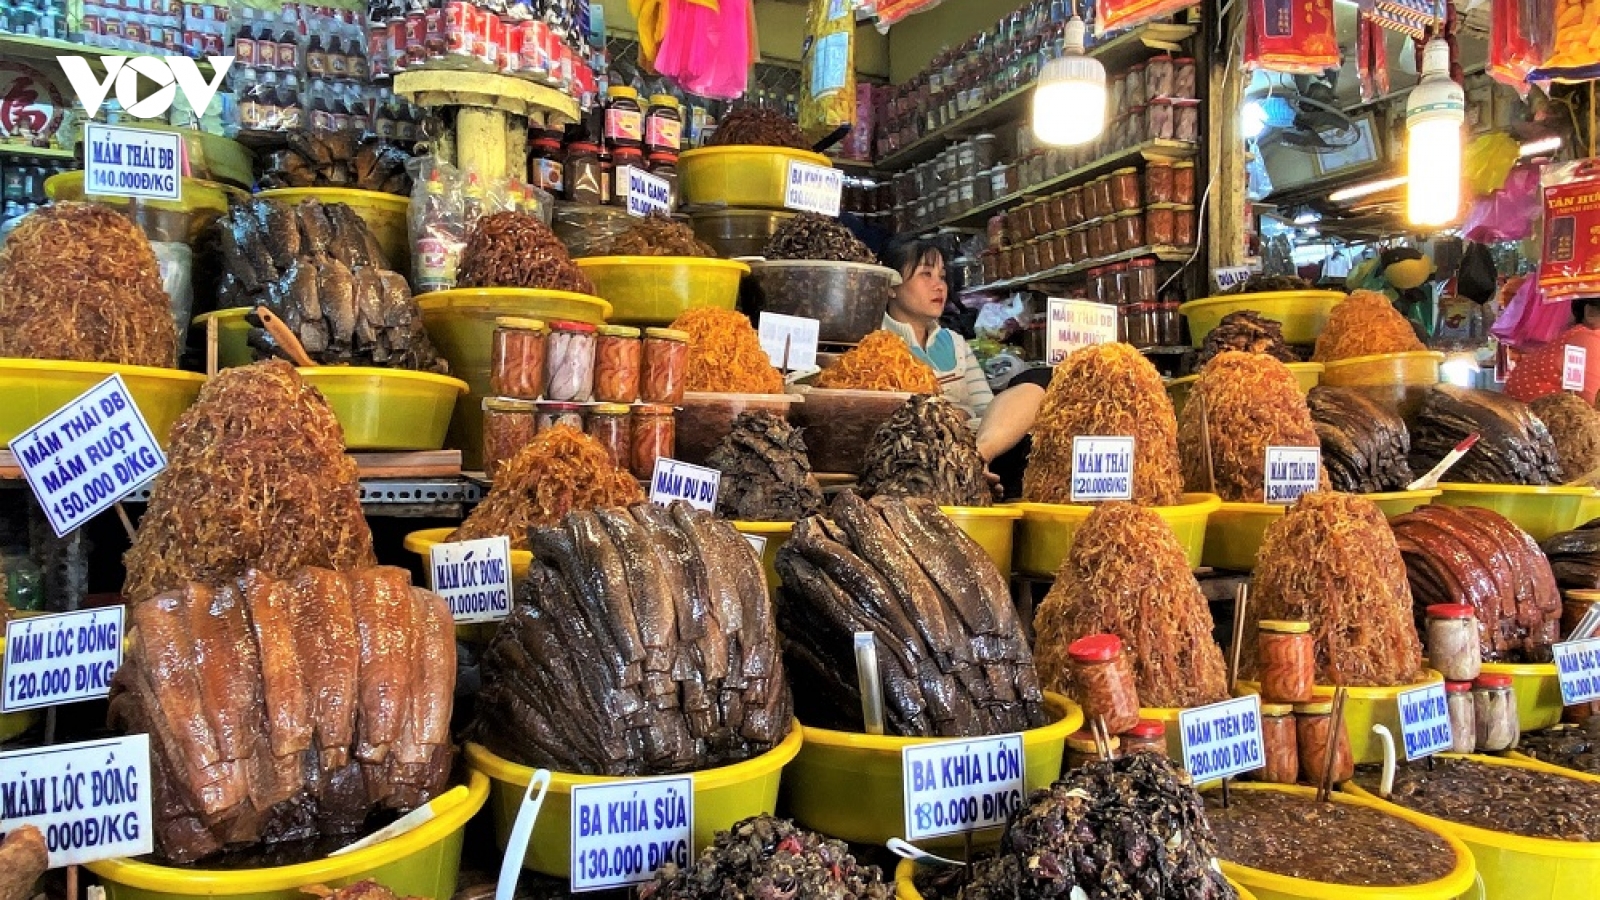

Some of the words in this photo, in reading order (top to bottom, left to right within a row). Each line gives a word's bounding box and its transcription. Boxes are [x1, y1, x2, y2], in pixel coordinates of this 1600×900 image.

[93, 131, 122, 165] MẮM
[126, 140, 155, 168] THÁI
[94, 169, 173, 192] 140.000Đ/KG
[22, 432, 63, 468] MẮM
[60, 405, 102, 442] THÁI
[99, 391, 126, 418] ĐB
[41, 456, 87, 494] MẮM
[85, 421, 135, 466] RUỘT
[1105, 447, 1128, 473] THÁI
[53, 472, 116, 523] 150.000
[112, 446, 158, 485] Đ/KG
[461, 550, 478, 588] LÓC
[444, 589, 507, 615] 0.000Đ/KG
[11, 623, 43, 664] MẮM
[47, 621, 74, 658] LÓC
[9, 668, 70, 701] 120.000
[75, 660, 115, 692] Đ/KG
[912, 758, 936, 791] BA
[941, 745, 983, 788] KHÍA
[987, 741, 1020, 782] LỚN
[1190, 746, 1231, 775] 280.000
[51, 762, 85, 813] LÓC
[983, 789, 1020, 821] Đ/KG
[580, 803, 602, 837] BA
[608, 791, 648, 834] KHÍA
[654, 787, 687, 830] SỮA
[579, 844, 643, 880] 130.000
[648, 839, 687, 871] Đ/KG
